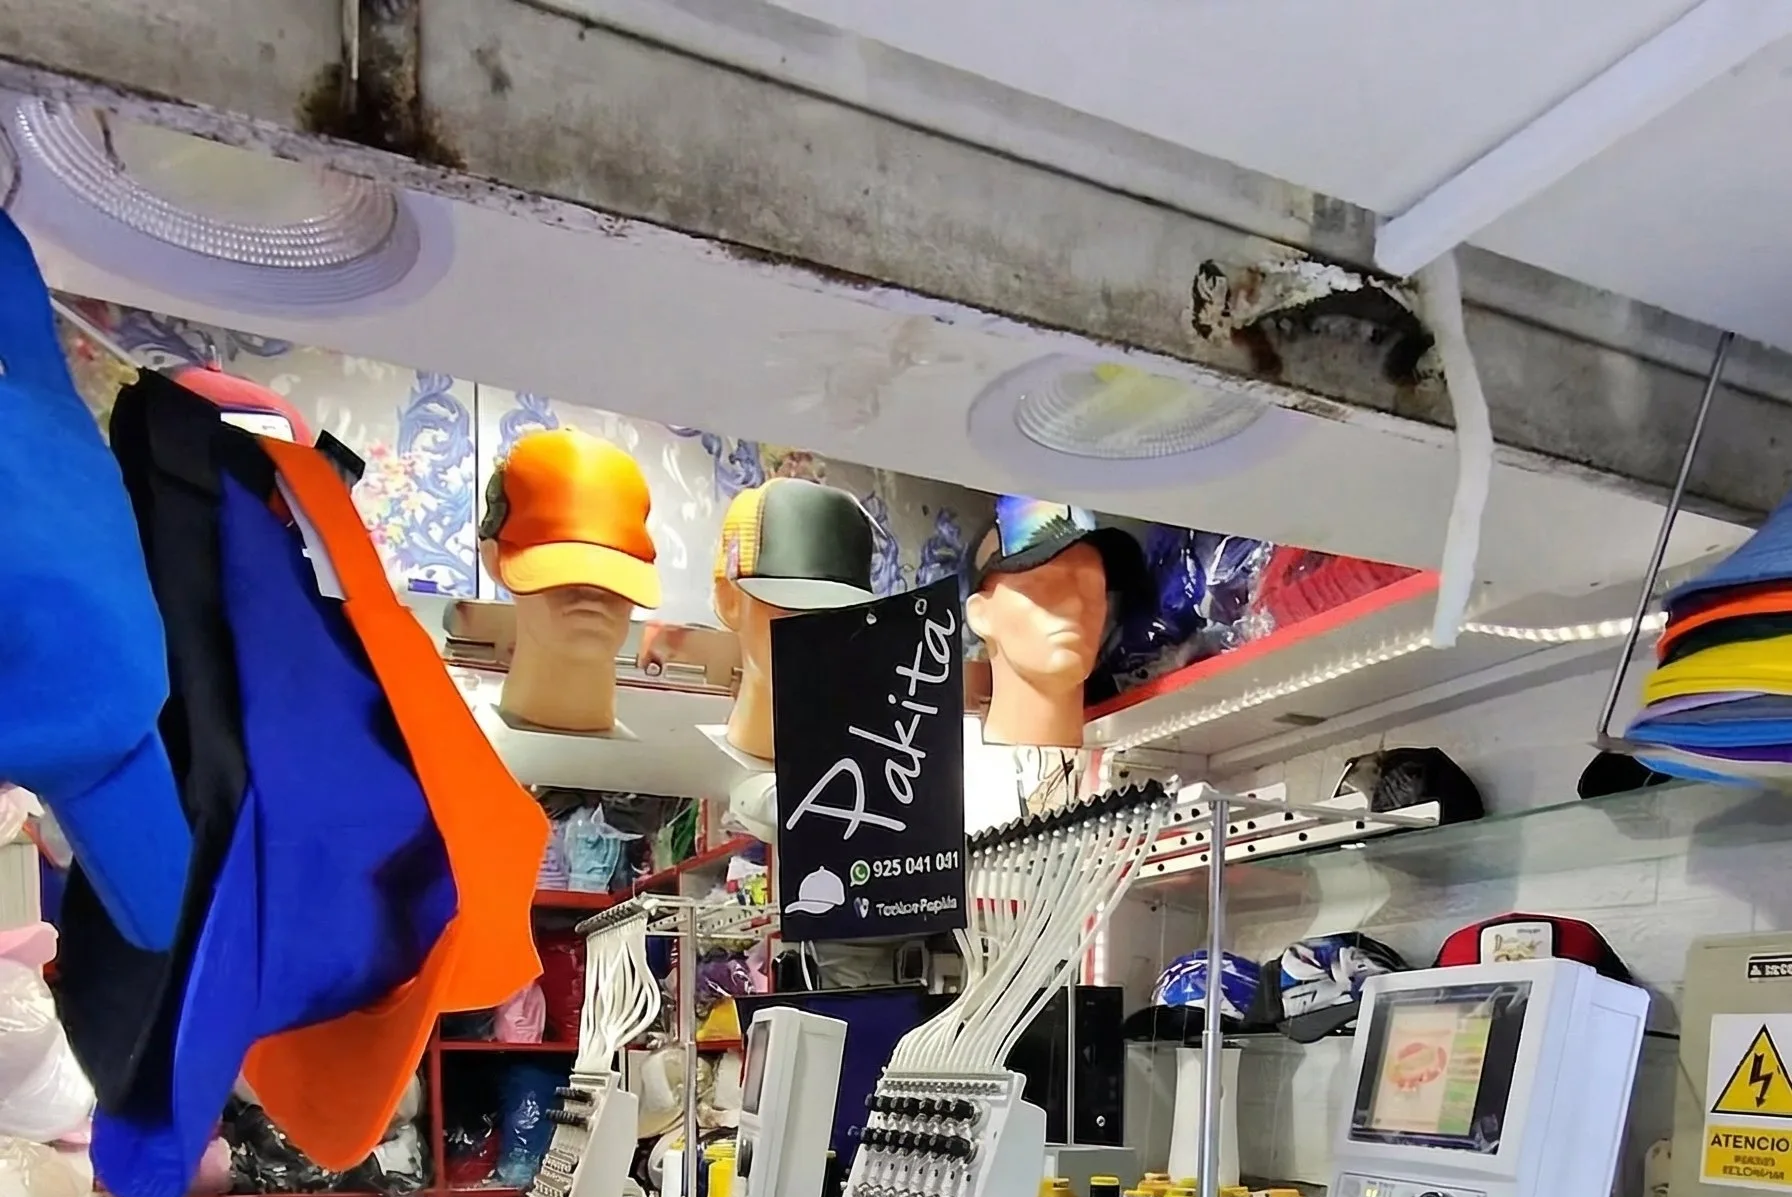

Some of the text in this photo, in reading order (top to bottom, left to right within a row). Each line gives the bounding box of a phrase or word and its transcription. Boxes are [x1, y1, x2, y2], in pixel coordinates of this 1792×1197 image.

[786, 608, 956, 840] Pakita
[872, 858, 902, 878] 925
[905, 855, 931, 875] 041
